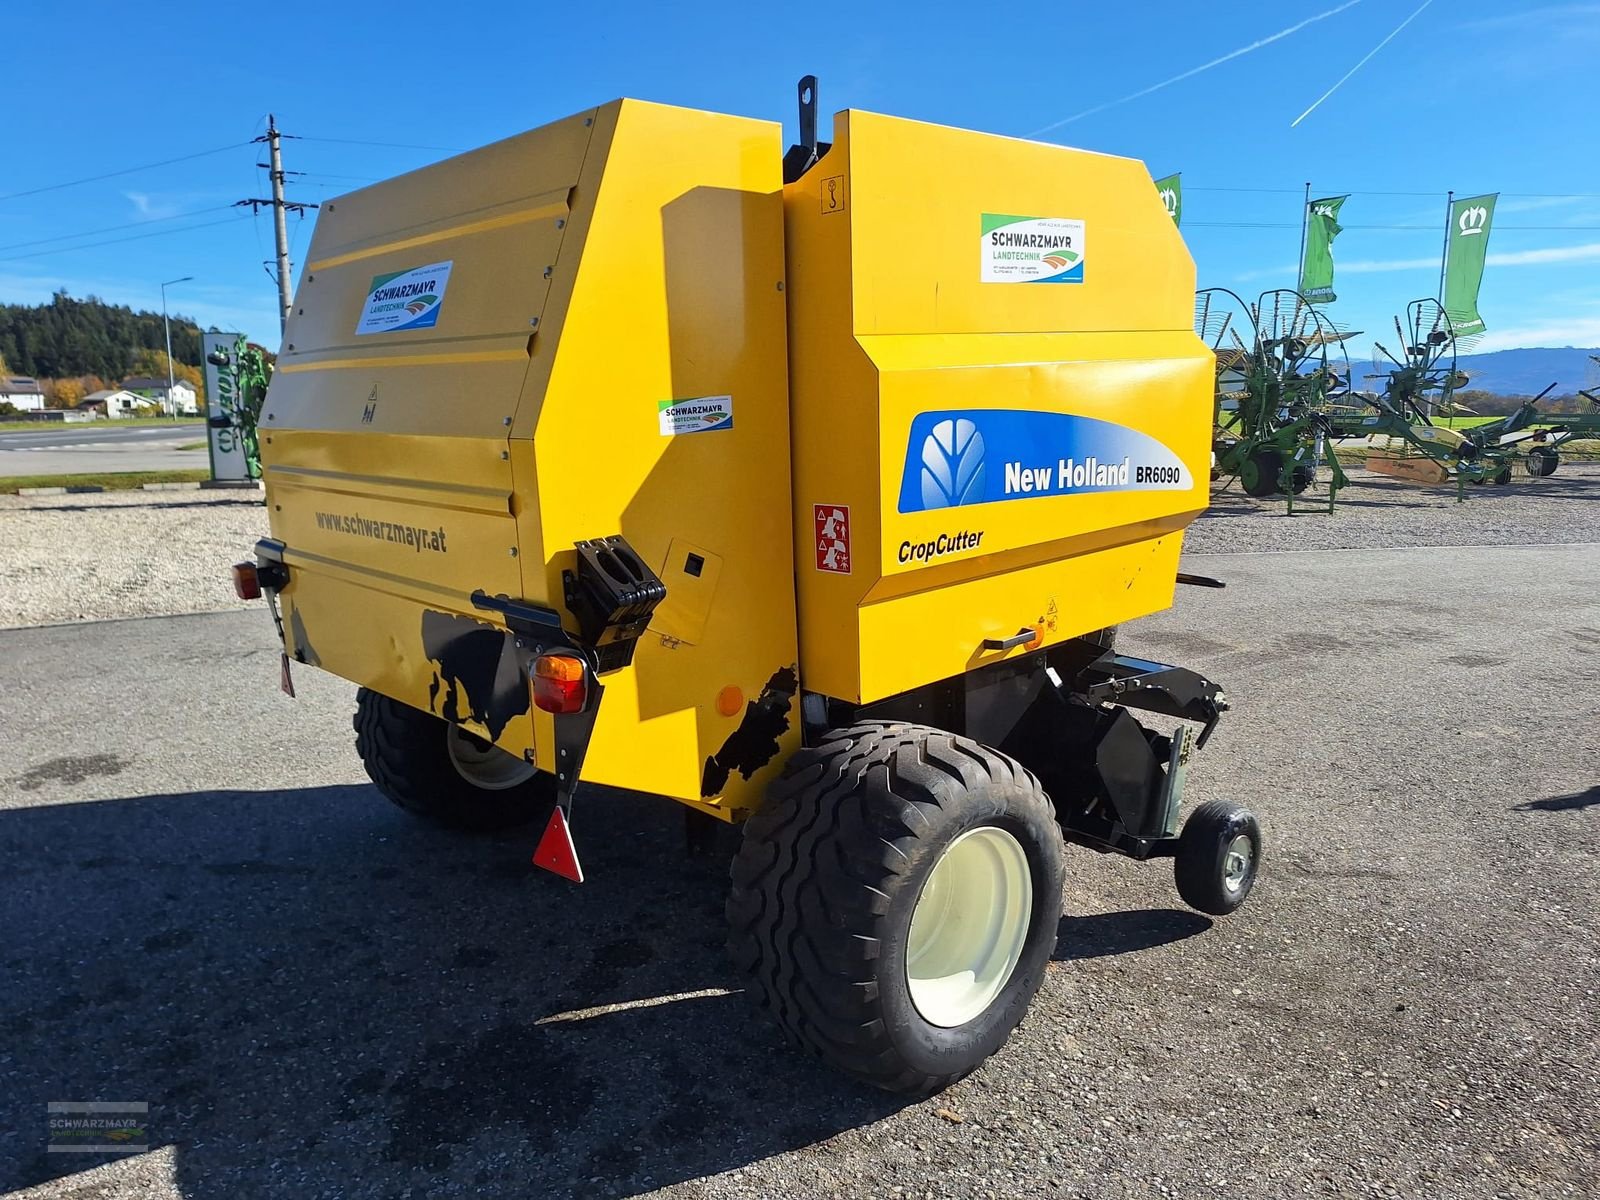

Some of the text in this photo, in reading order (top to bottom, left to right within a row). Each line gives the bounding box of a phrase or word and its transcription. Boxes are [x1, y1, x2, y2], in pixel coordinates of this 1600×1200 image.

[992, 231, 1072, 249] SCHWARZMAYR
[993, 251, 1041, 261] LANDTECHNIK
[373, 280, 436, 302] SCHWARZMAYR
[370, 302, 405, 314] LANDTECHNIK
[666, 404, 723, 417] SCHWARZMAYR
[1005, 457, 1180, 494] New Holland BR6090
[315, 511, 447, 553] www.schwarzmayr.at
[898, 530, 984, 563] CropCutter
